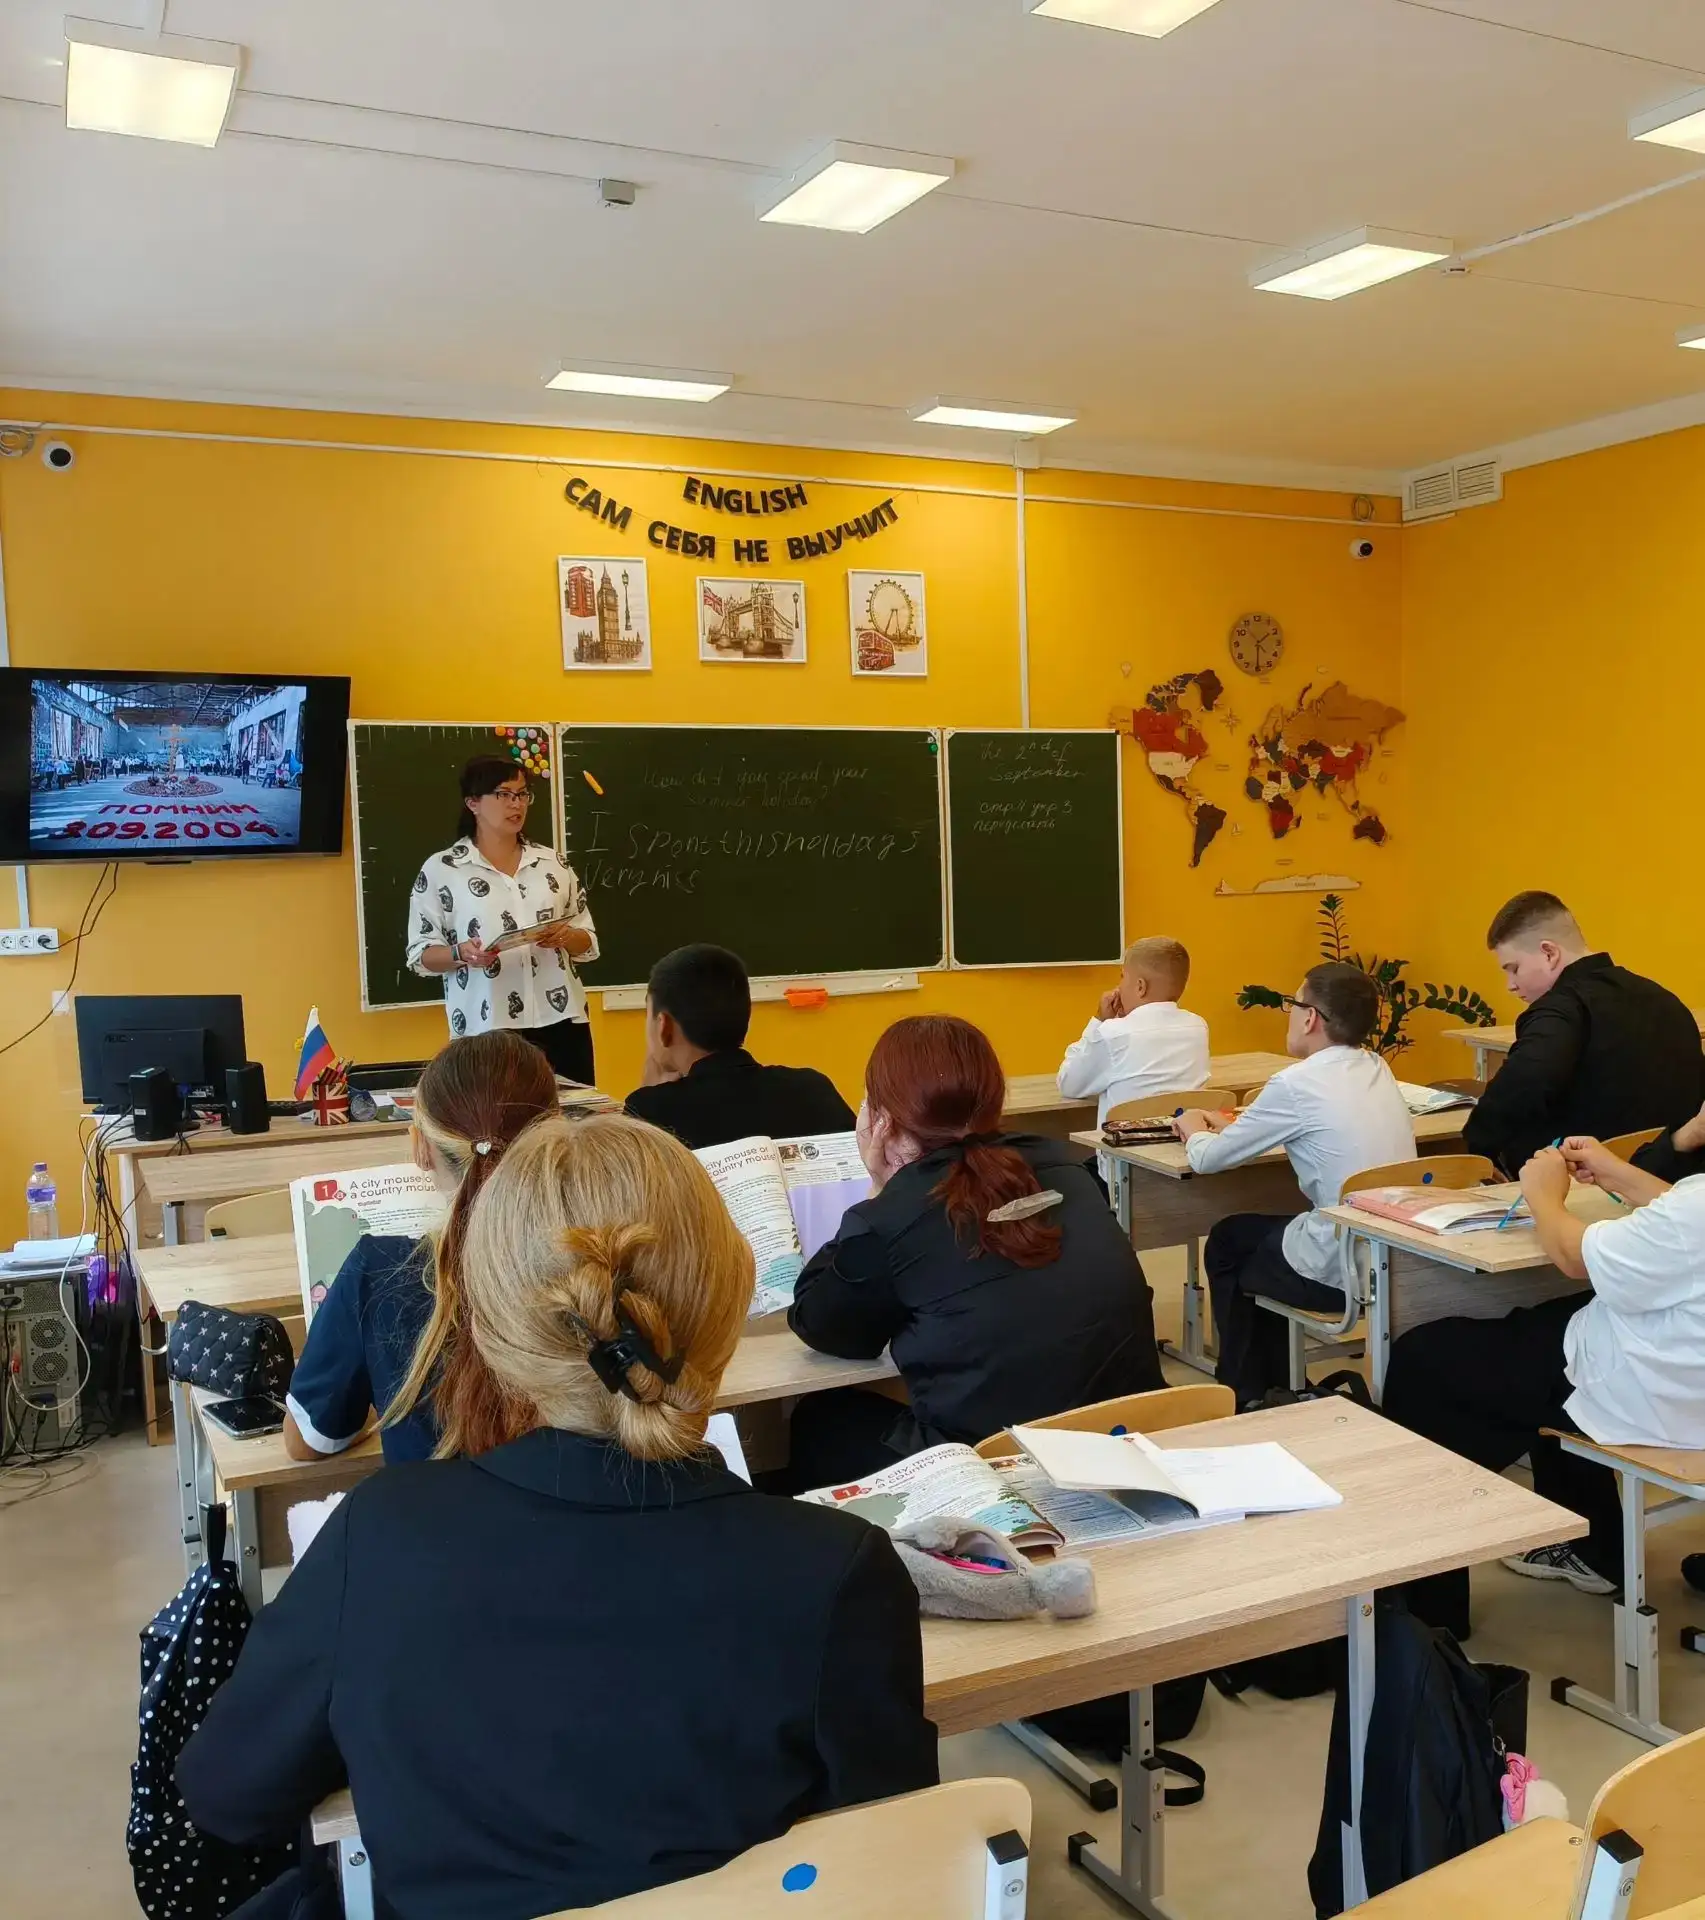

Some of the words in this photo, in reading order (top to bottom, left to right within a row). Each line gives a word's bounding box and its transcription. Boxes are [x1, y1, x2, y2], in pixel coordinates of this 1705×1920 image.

[682, 476, 809, 514] ENGLISH
[564, 477, 633, 531] САМ
[648, 520, 716, 560] СЕБЯ
[734, 539, 770, 563] НЕ
[787, 498, 899, 561] ВЫУЧИТ
[98, 803, 260, 815] ПОМНИМ
[585, 811, 614, 852] I
[705, 1160, 721, 1171] city
[724, 1148, 757, 1163] mouse
[712, 1160, 743, 1176] ountry
[350, 1181, 358, 1190] A
[361, 1179, 380, 1189] city
[384, 1176, 421, 1185] mouse
[361, 1186, 402, 1198] country
[406, 1184, 437, 1192] mous
